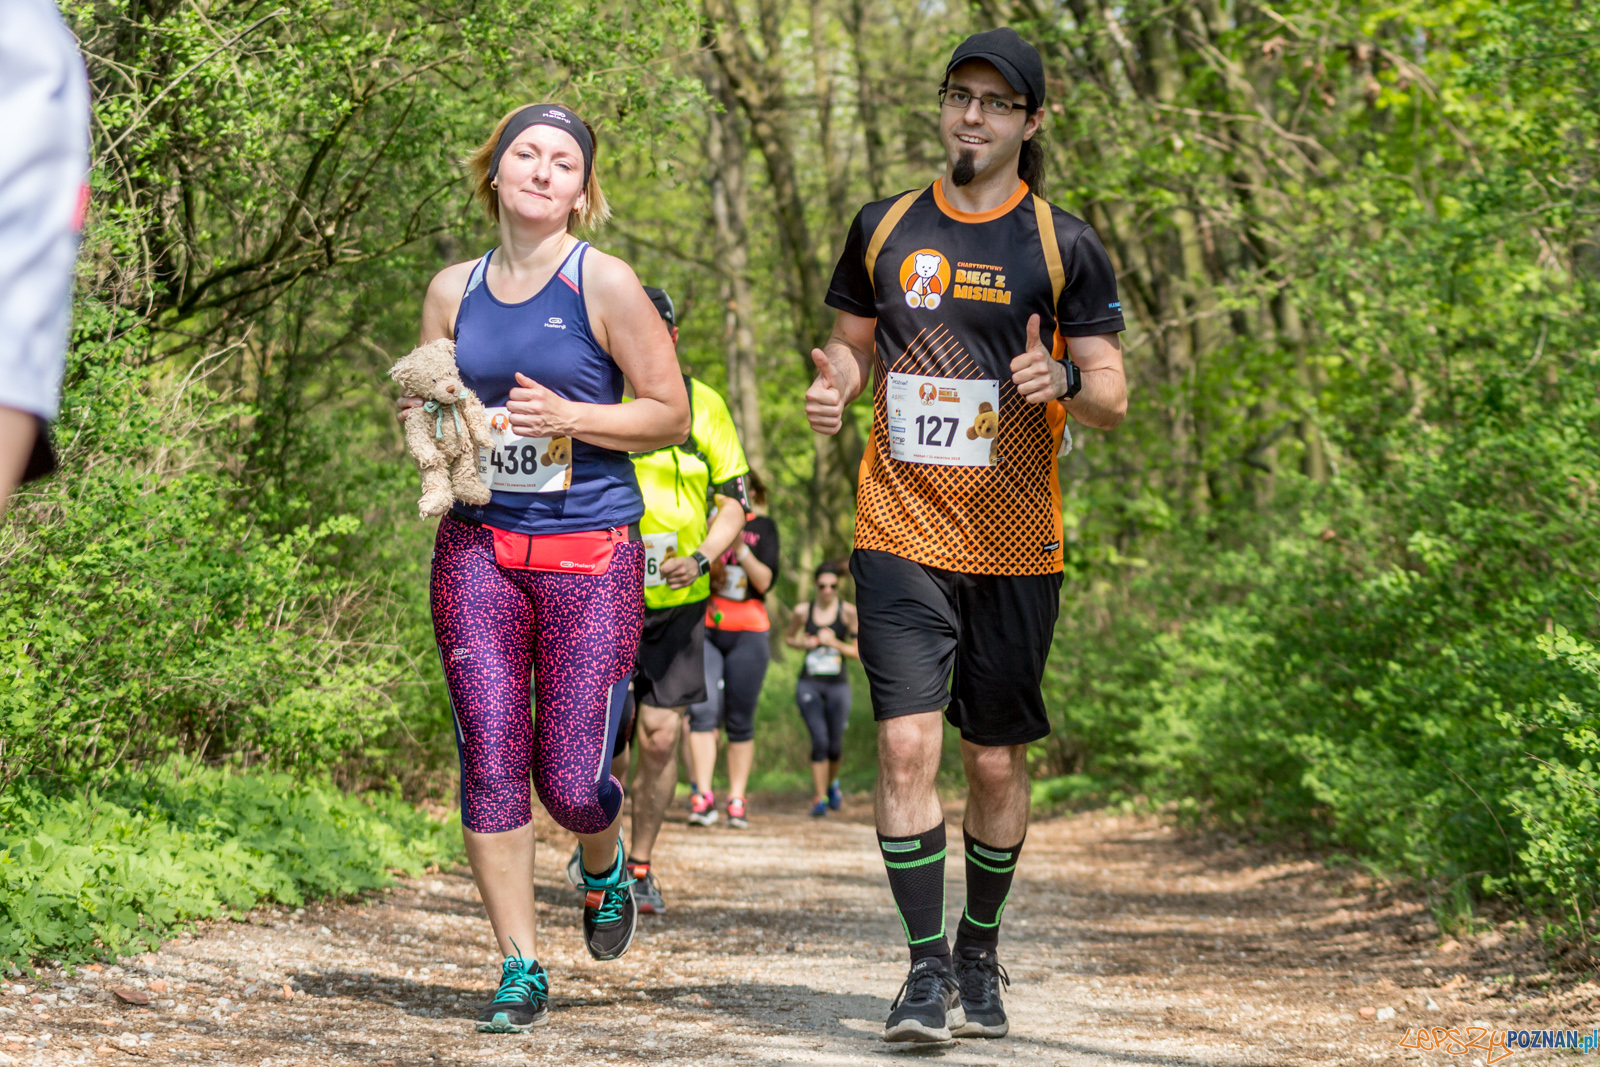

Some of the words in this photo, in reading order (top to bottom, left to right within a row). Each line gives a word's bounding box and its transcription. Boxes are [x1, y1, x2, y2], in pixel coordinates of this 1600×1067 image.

[957, 261, 1003, 272] CHARYTATYWNY
[955, 269, 991, 286] BIEG
[994, 274, 1006, 288] Z
[953, 284, 1012, 305] MISIEM
[915, 415, 960, 447] 127
[490, 444, 538, 475] 438
[645, 557, 657, 575] 6
